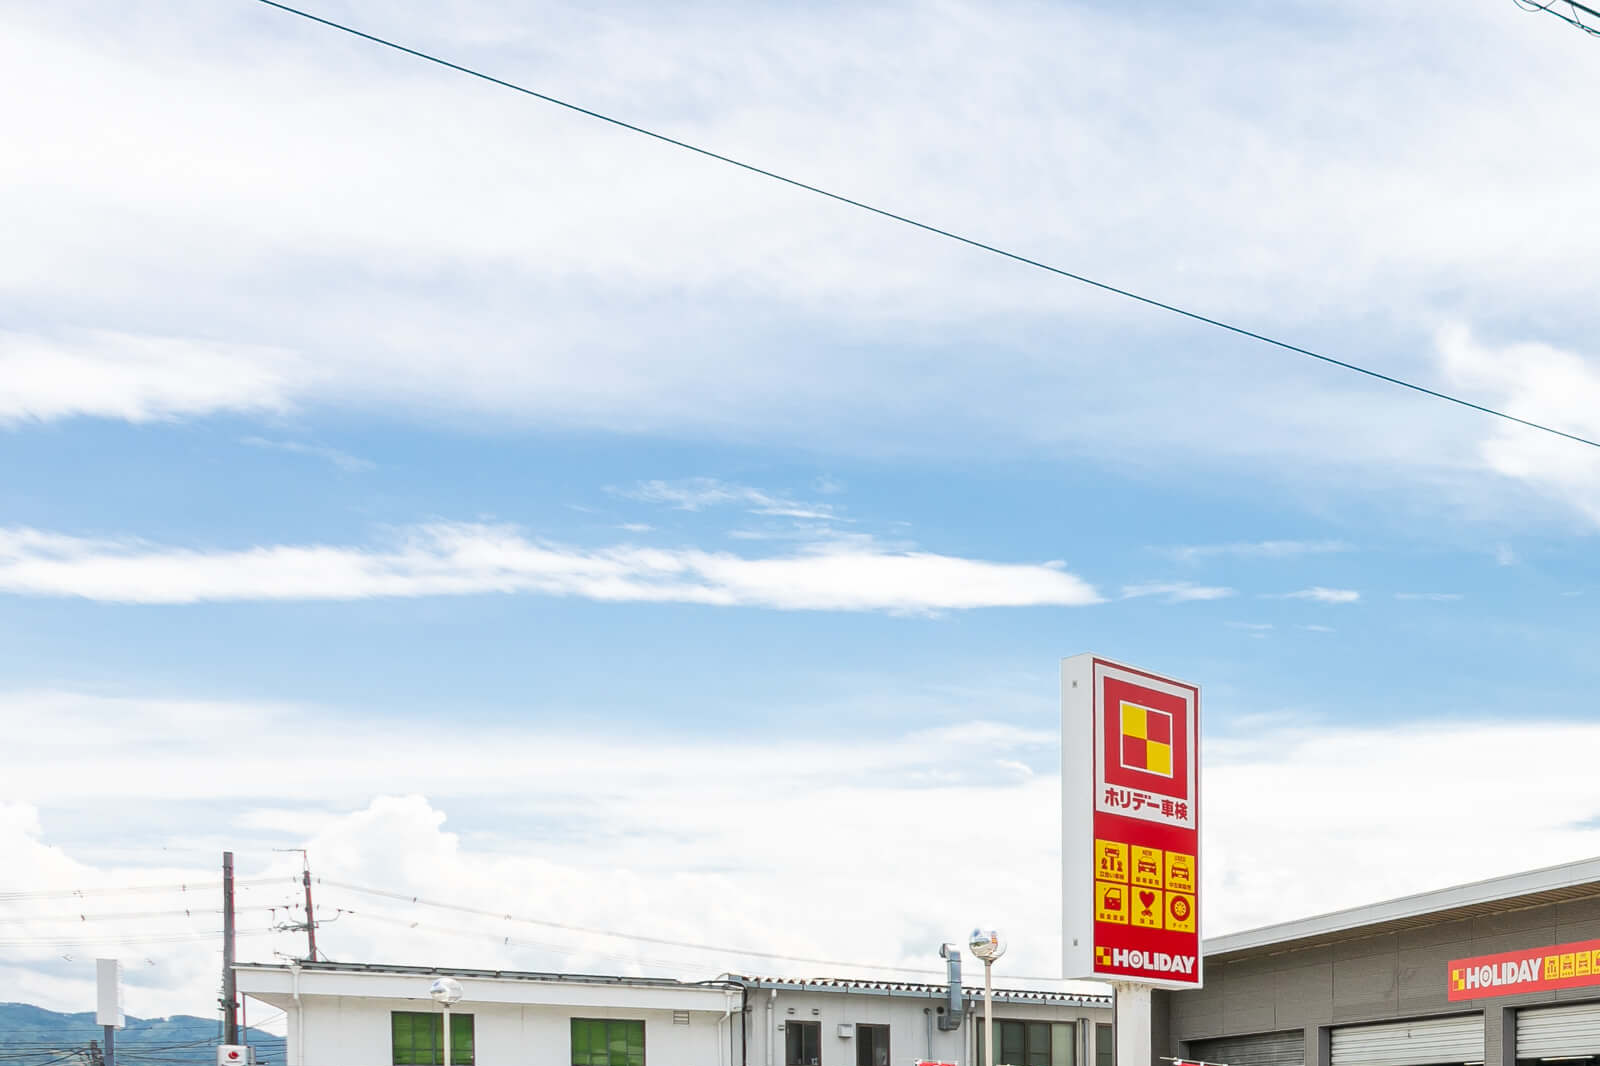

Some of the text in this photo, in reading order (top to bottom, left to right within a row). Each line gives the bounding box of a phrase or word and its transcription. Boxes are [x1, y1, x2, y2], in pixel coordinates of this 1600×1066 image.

[1104, 787, 1189, 821] ホリデー車検
[1112, 947, 1196, 974] HOLIDAY
[1465, 957, 1542, 990] HOLIDAY
